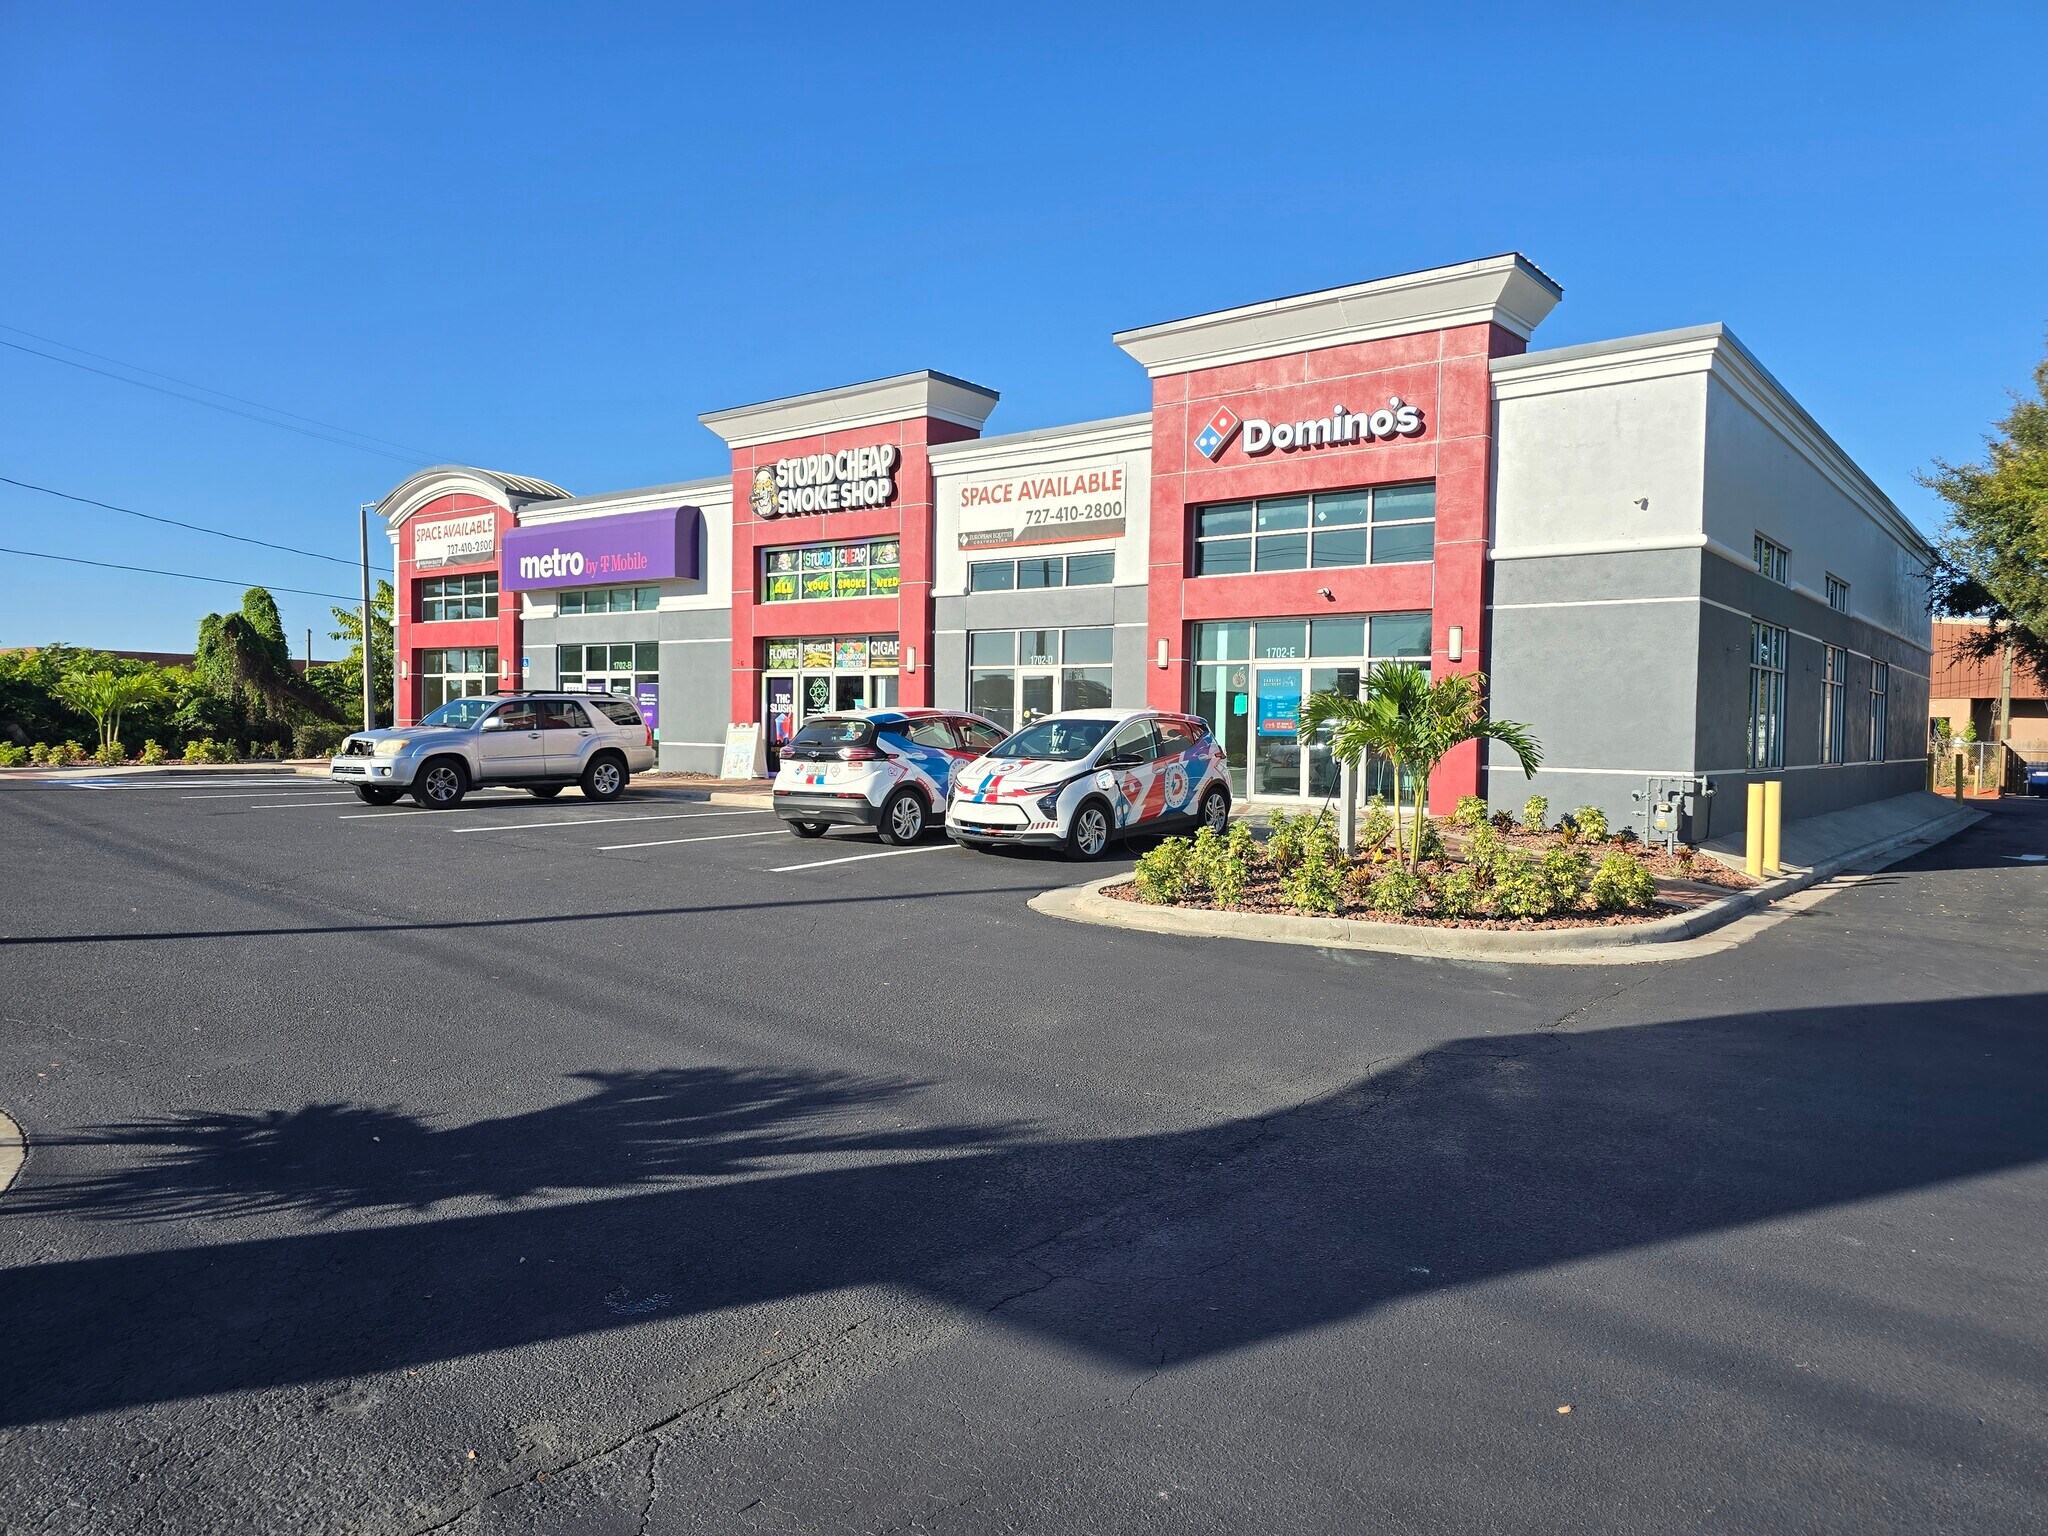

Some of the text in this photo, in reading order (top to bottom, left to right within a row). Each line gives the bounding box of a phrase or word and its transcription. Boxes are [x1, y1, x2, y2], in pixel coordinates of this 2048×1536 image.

[1243, 396, 1419, 452] Domino's
[776, 444, 894, 488] STUPID CHEAP
[777, 478, 892, 514] SMOKE SHOP
[961, 469, 1122, 508] SPACE AVAILABLE
[1026, 501, 1122, 525] 727-410-2800
[416, 518, 493, 542] SPACE AVAILABLE
[520, 548, 584, 579] metro
[585, 558, 598, 578] by
[804, 547, 866, 567] STUPID CHEAP
[774, 577, 900, 594] ALL YOUR SMOKE NEED
[769, 648, 798, 660] FLOWER
[1030, 655, 1054, 665] 1702-D
[1265, 646, 1296, 658] 1702-E
[613, 661, 632, 669] 1702-B
[775, 693, 791, 704] THC
[809, 686, 829, 697] OPEN
